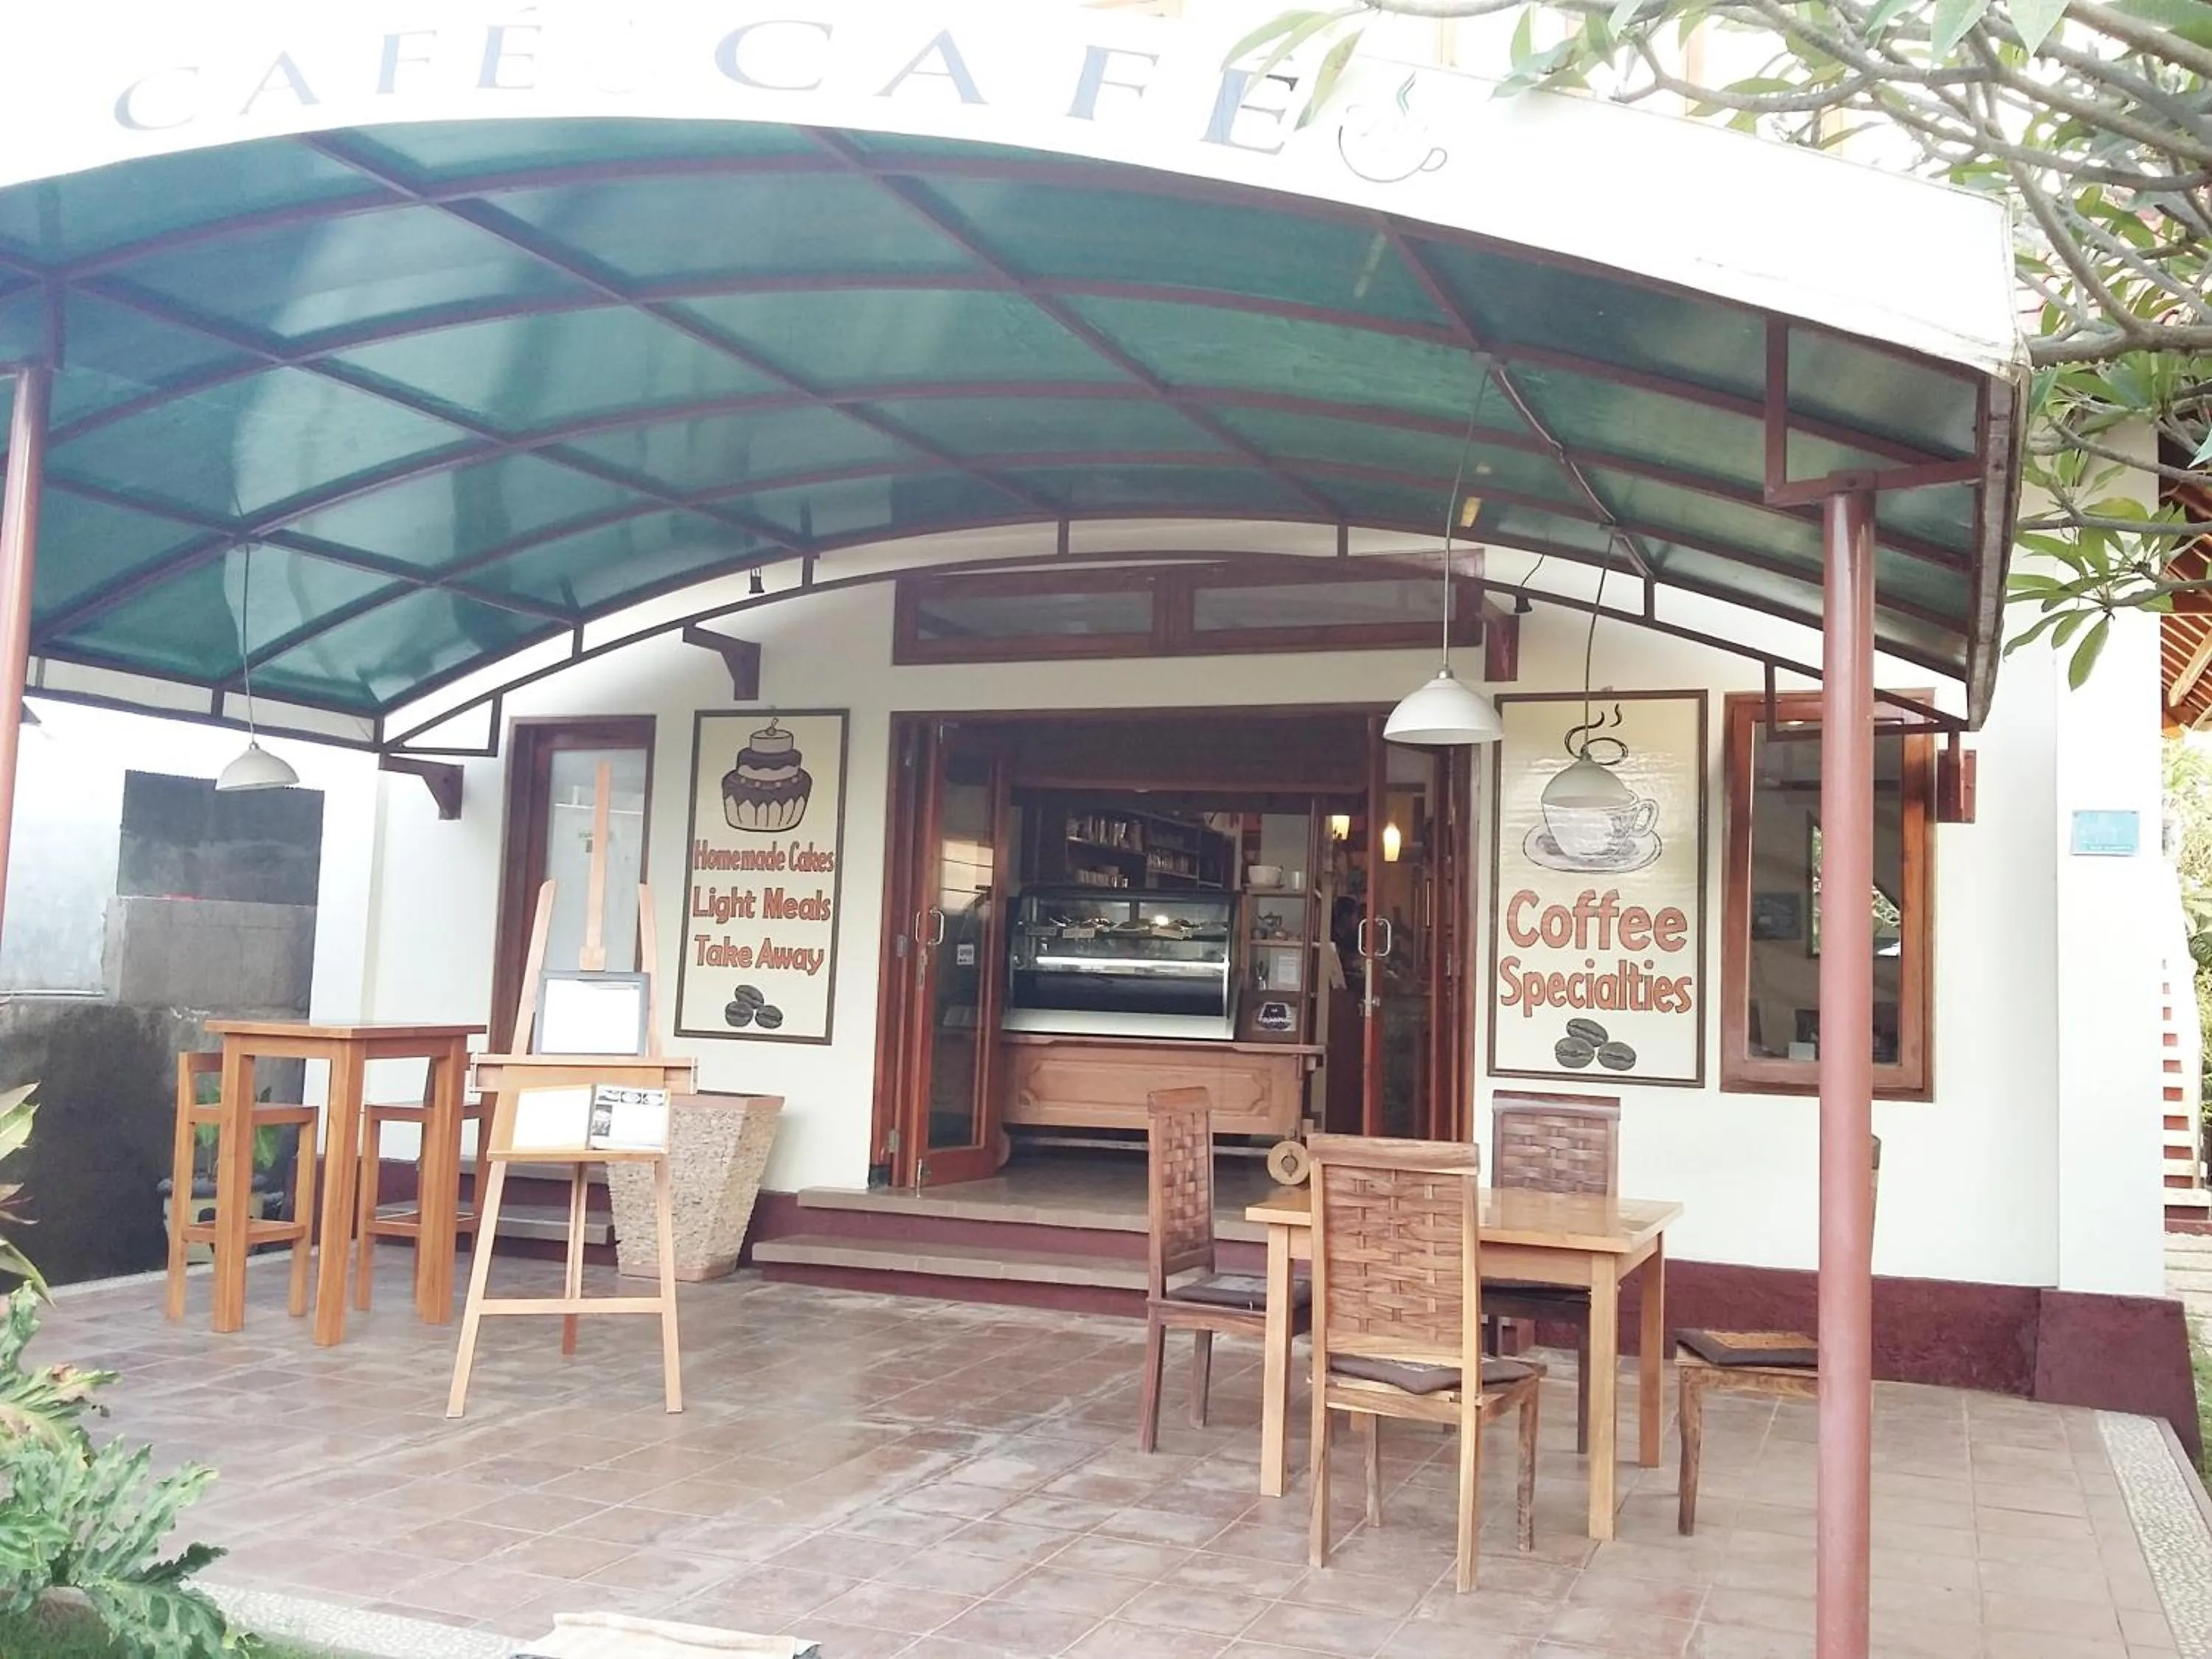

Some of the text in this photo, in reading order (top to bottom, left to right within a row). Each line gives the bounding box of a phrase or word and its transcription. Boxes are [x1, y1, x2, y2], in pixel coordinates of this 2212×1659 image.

[114, 6, 542, 131] CAFÉ
[693, 840, 834, 872] Homemade Cakes
[692, 886, 831, 925] Light Meals
[1506, 888, 1688, 951] Coffee
[694, 934, 825, 975] Take Away
[1499, 955, 1693, 1018] Specialties
